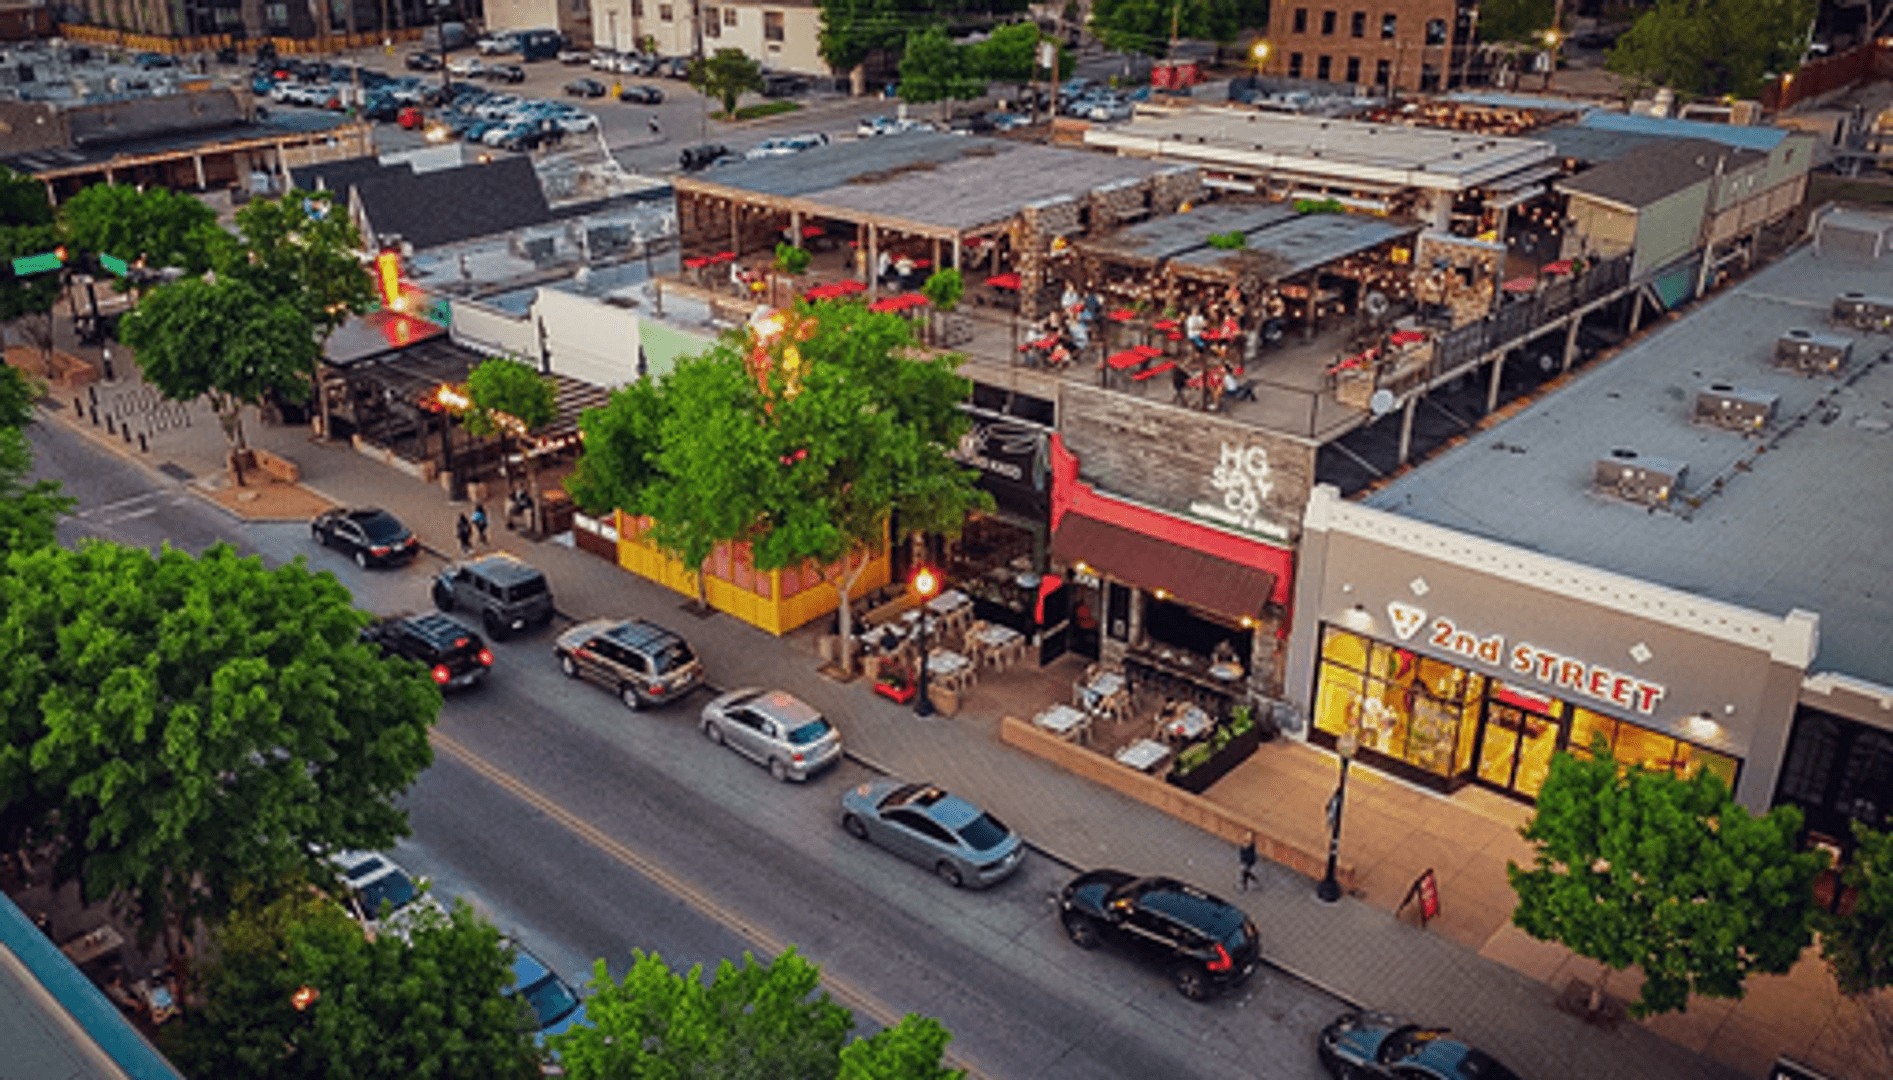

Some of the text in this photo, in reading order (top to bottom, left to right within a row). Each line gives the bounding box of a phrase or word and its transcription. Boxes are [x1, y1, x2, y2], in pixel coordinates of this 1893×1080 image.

[1220, 441, 1269, 478] HG
[1430, 617, 1664, 714] 2nd STREET
